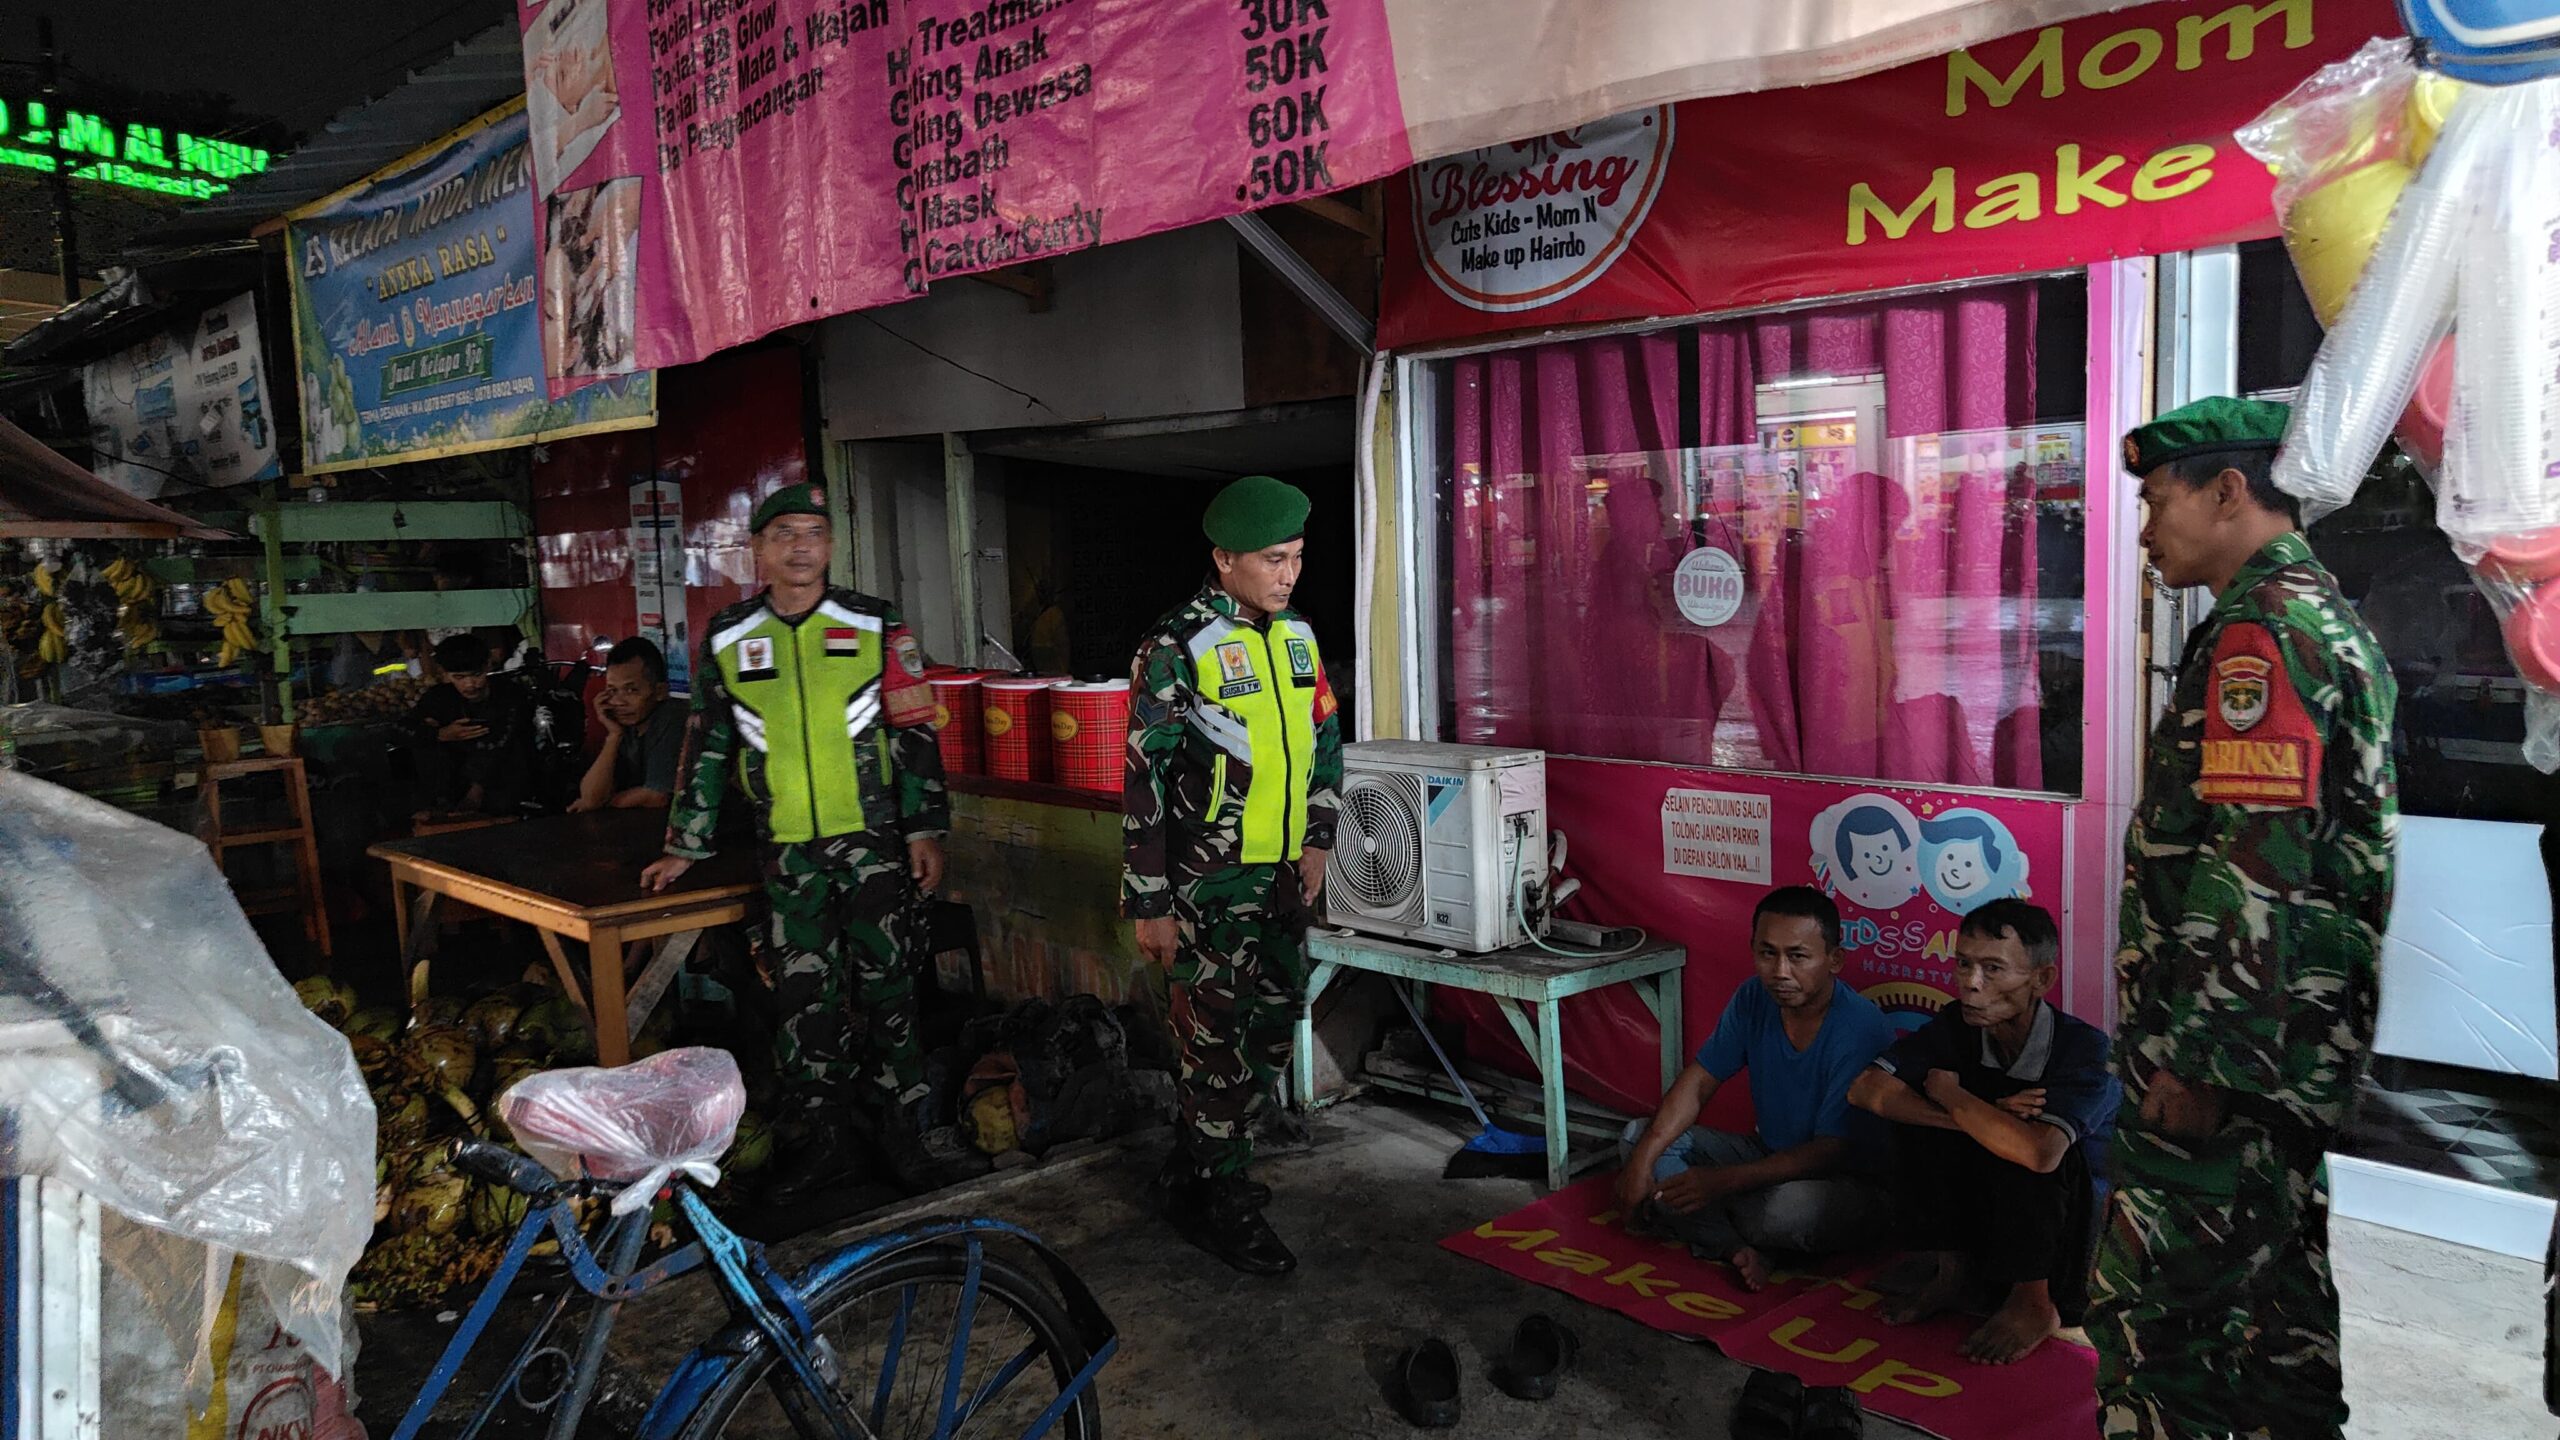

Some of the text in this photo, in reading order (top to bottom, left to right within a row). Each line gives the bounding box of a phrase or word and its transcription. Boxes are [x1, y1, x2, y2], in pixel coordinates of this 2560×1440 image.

[649, 1, 693, 61] Facial
[653, 42, 698, 101] Facial
[737, 0, 777, 51] Glow
[973, 25, 1049, 85] Anak
[1246, 25, 1330, 93] 50K
[1945, 0, 2316, 117] Mom
[656, 81, 699, 138] Facial
[737, 45, 777, 93] Mata
[973, 63, 1092, 131] Dewasa
[1248, 84, 1330, 149] 60K
[1250, 140, 1333, 201] 50K
[1428, 153, 1639, 227] Blessing
[1846, 143, 2217, 246] Make
[304, 234, 327, 278] ES
[328, 204, 404, 268] KELAPA
[408, 168, 477, 235] MUDA
[1451, 216, 1481, 246] Cuts
[1484, 209, 1520, 237] Kids
[1536, 202, 1580, 230] Mom
[1582, 195, 1598, 223] N
[438, 233, 495, 277] RASA
[1460, 232, 1586, 274] Make up Hairdo
[1678, 573, 1738, 601] BUKA
[1224, 685, 1246, 697] SUSILO
[1427, 774, 1465, 787] DAIKIN
[1665, 795, 1768, 820] SELAIN PENGUNJUNG SALON
[1672, 821, 1759, 846] TOLONG JANGAN PARKIR
[1682, 848, 1706, 867] DEPAN
[1707, 850, 1732, 870] SALON
[1436, 912, 1450, 924] R32
